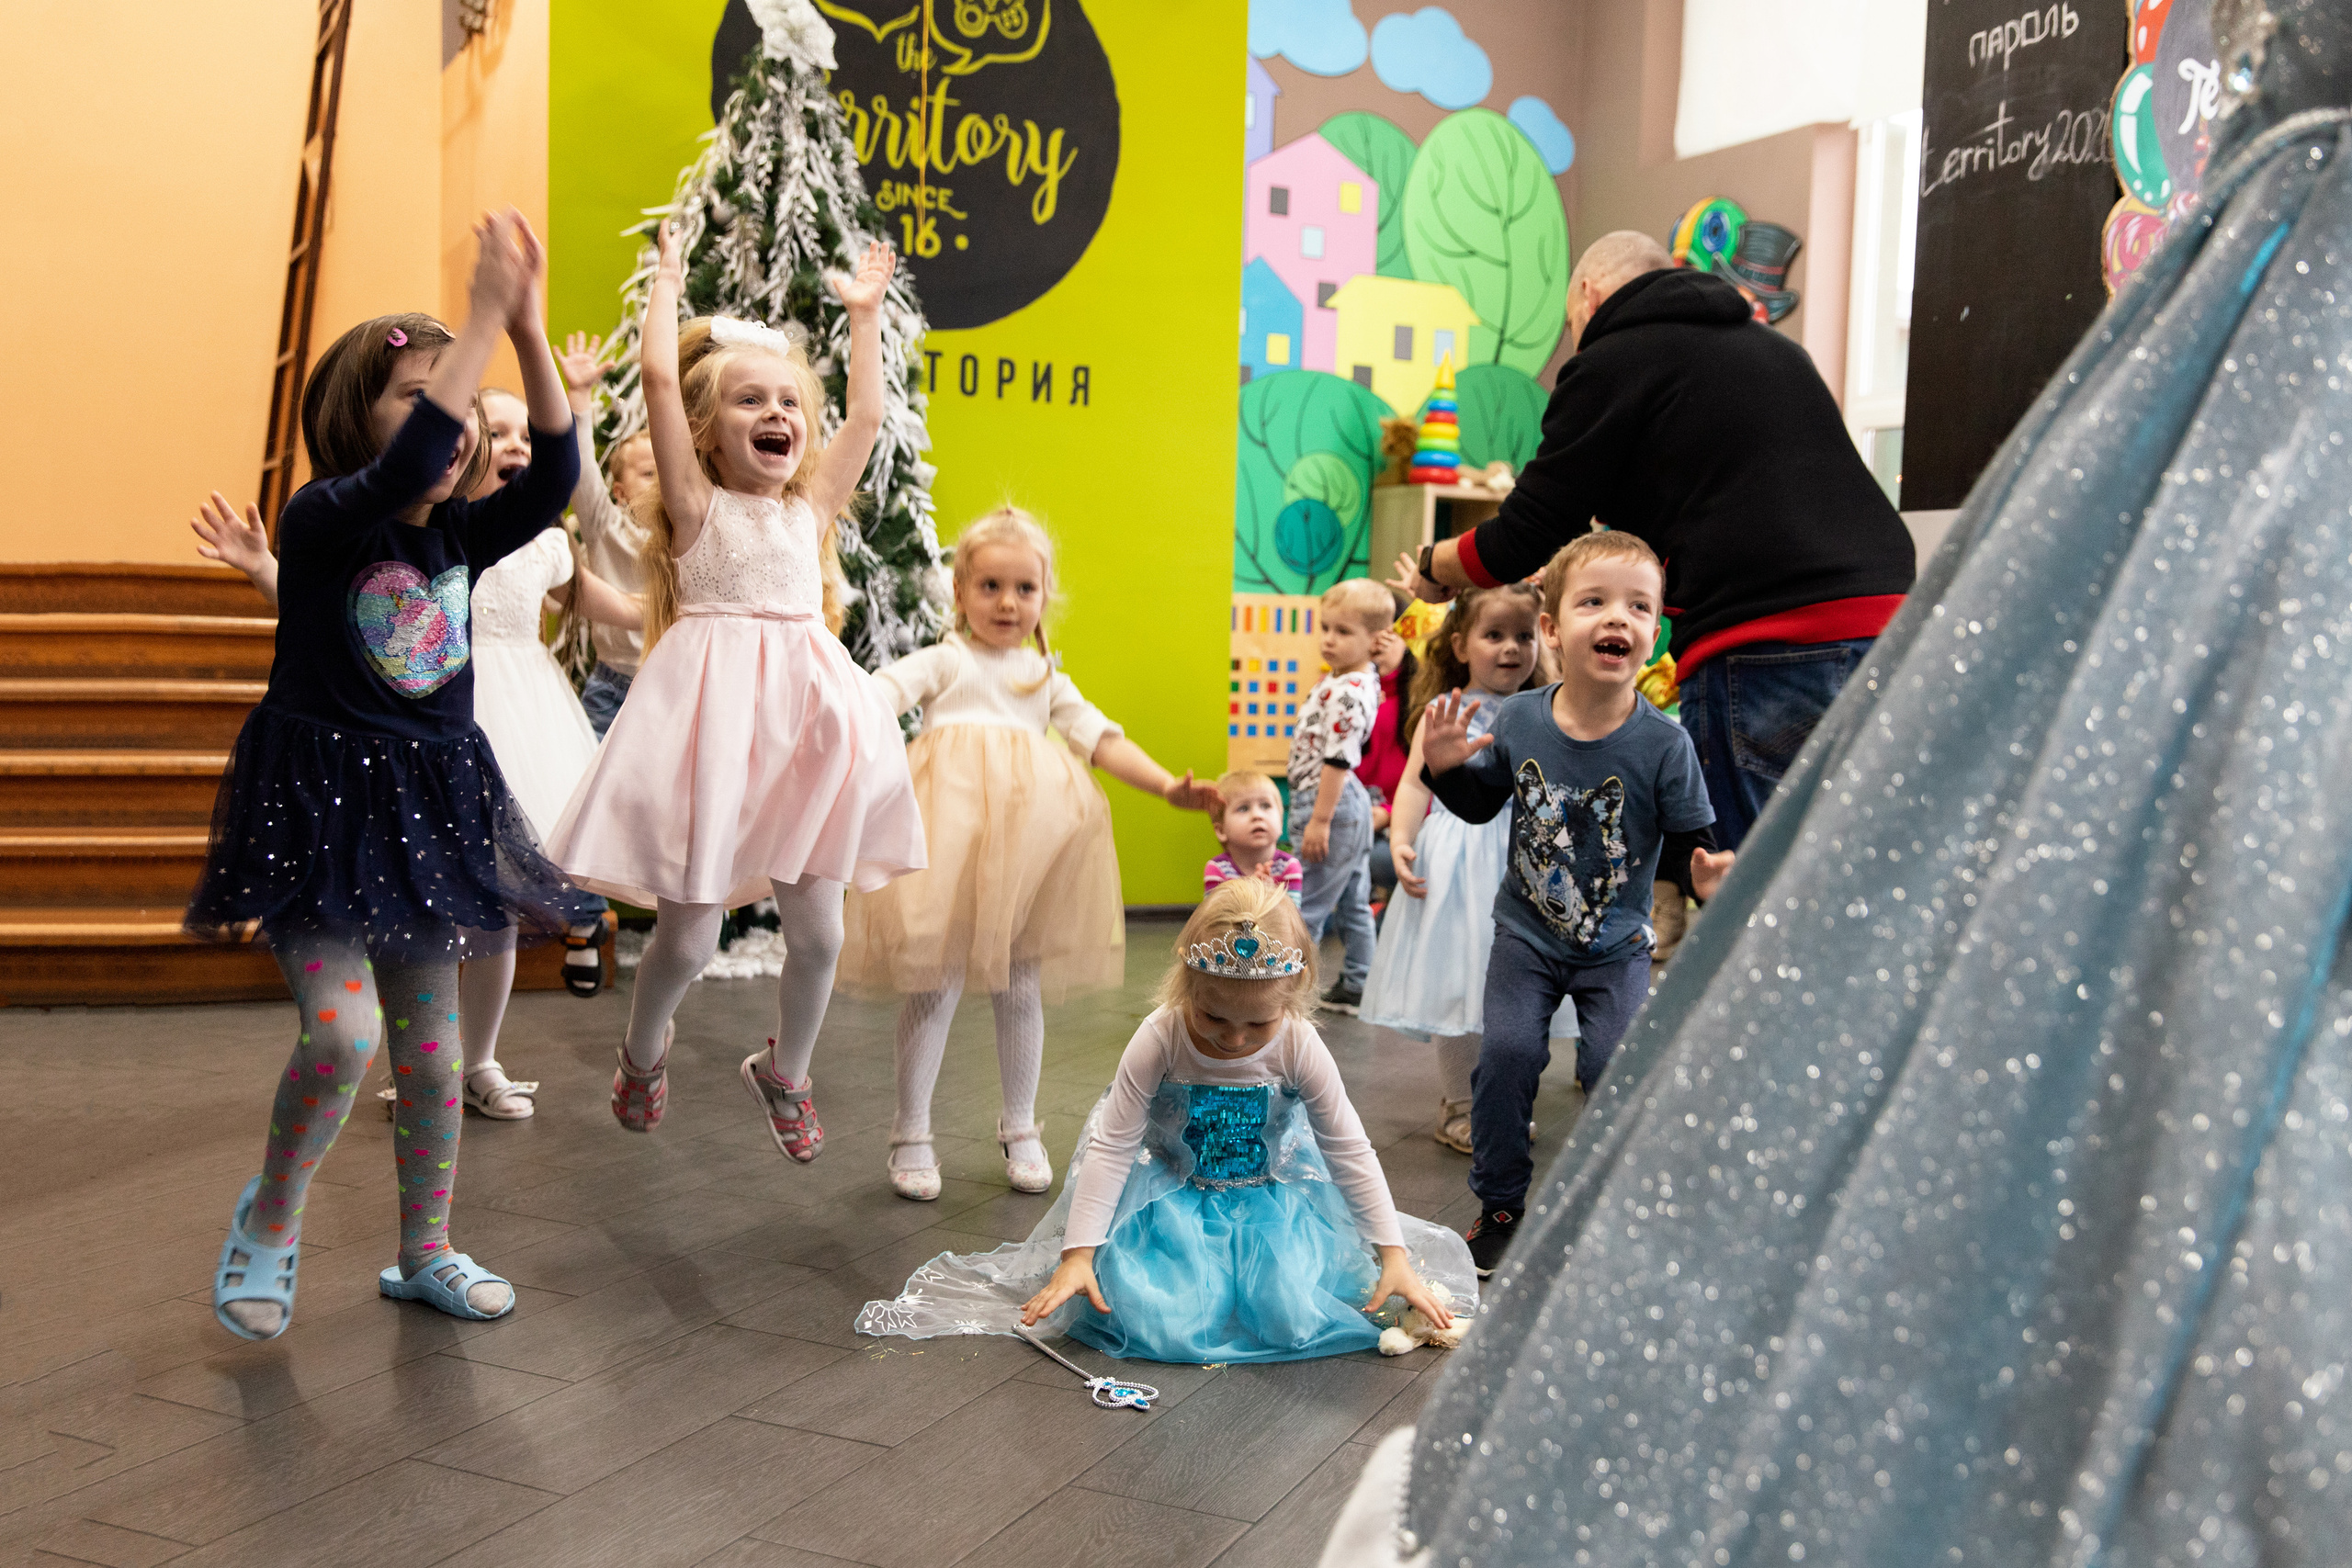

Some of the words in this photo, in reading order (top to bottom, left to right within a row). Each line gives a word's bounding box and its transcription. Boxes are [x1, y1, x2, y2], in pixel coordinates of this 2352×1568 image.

[823, 73, 1080, 226] rritory
[875, 178, 968, 220] SINCE
[923, 349, 1091, 407] ТОРИЯ
